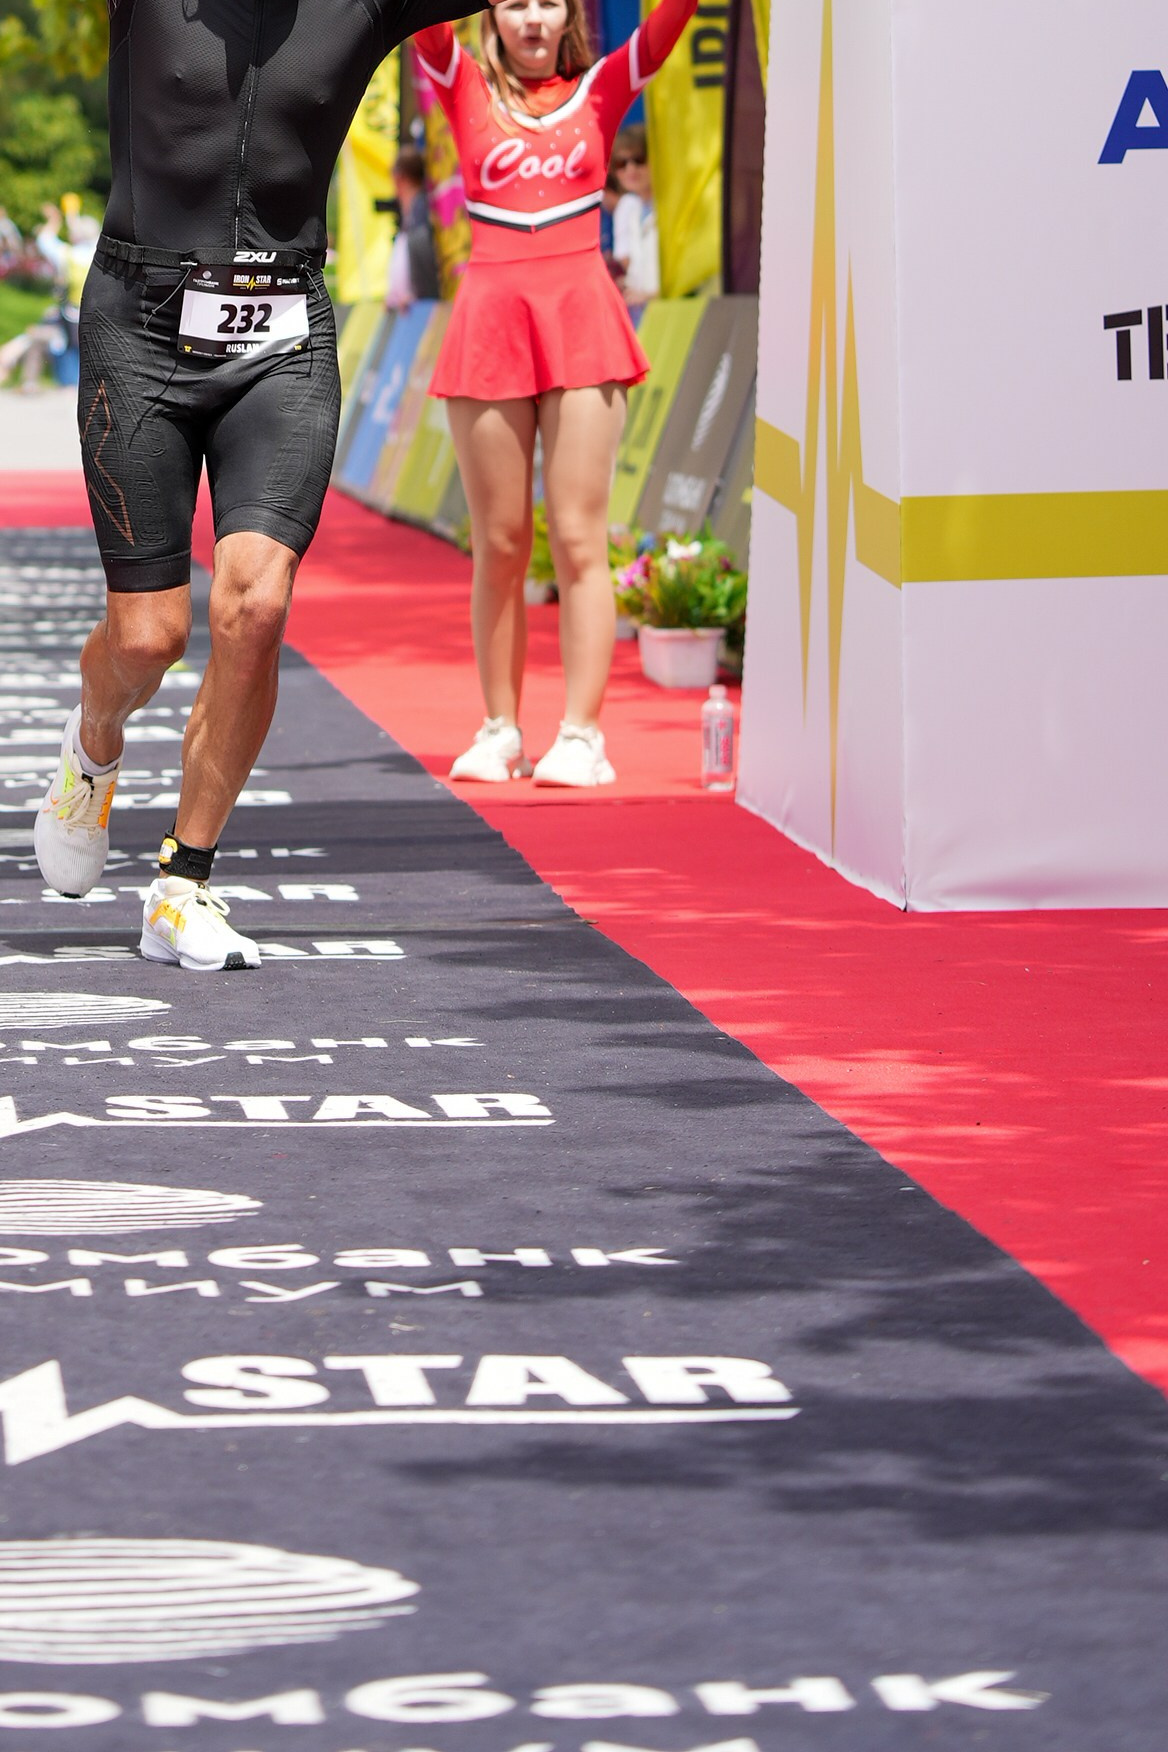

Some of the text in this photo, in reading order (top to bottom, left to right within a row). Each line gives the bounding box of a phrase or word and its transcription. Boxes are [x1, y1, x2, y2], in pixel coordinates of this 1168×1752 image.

[480, 136, 587, 191] Cool
[233, 251, 277, 263] 2XU
[233, 274, 250, 284] IRON
[255, 275, 272, 284] STAR
[217, 303, 272, 334] 232
[104, 1093, 553, 1120] STAR
[182, 1354, 793, 1409] STAR
